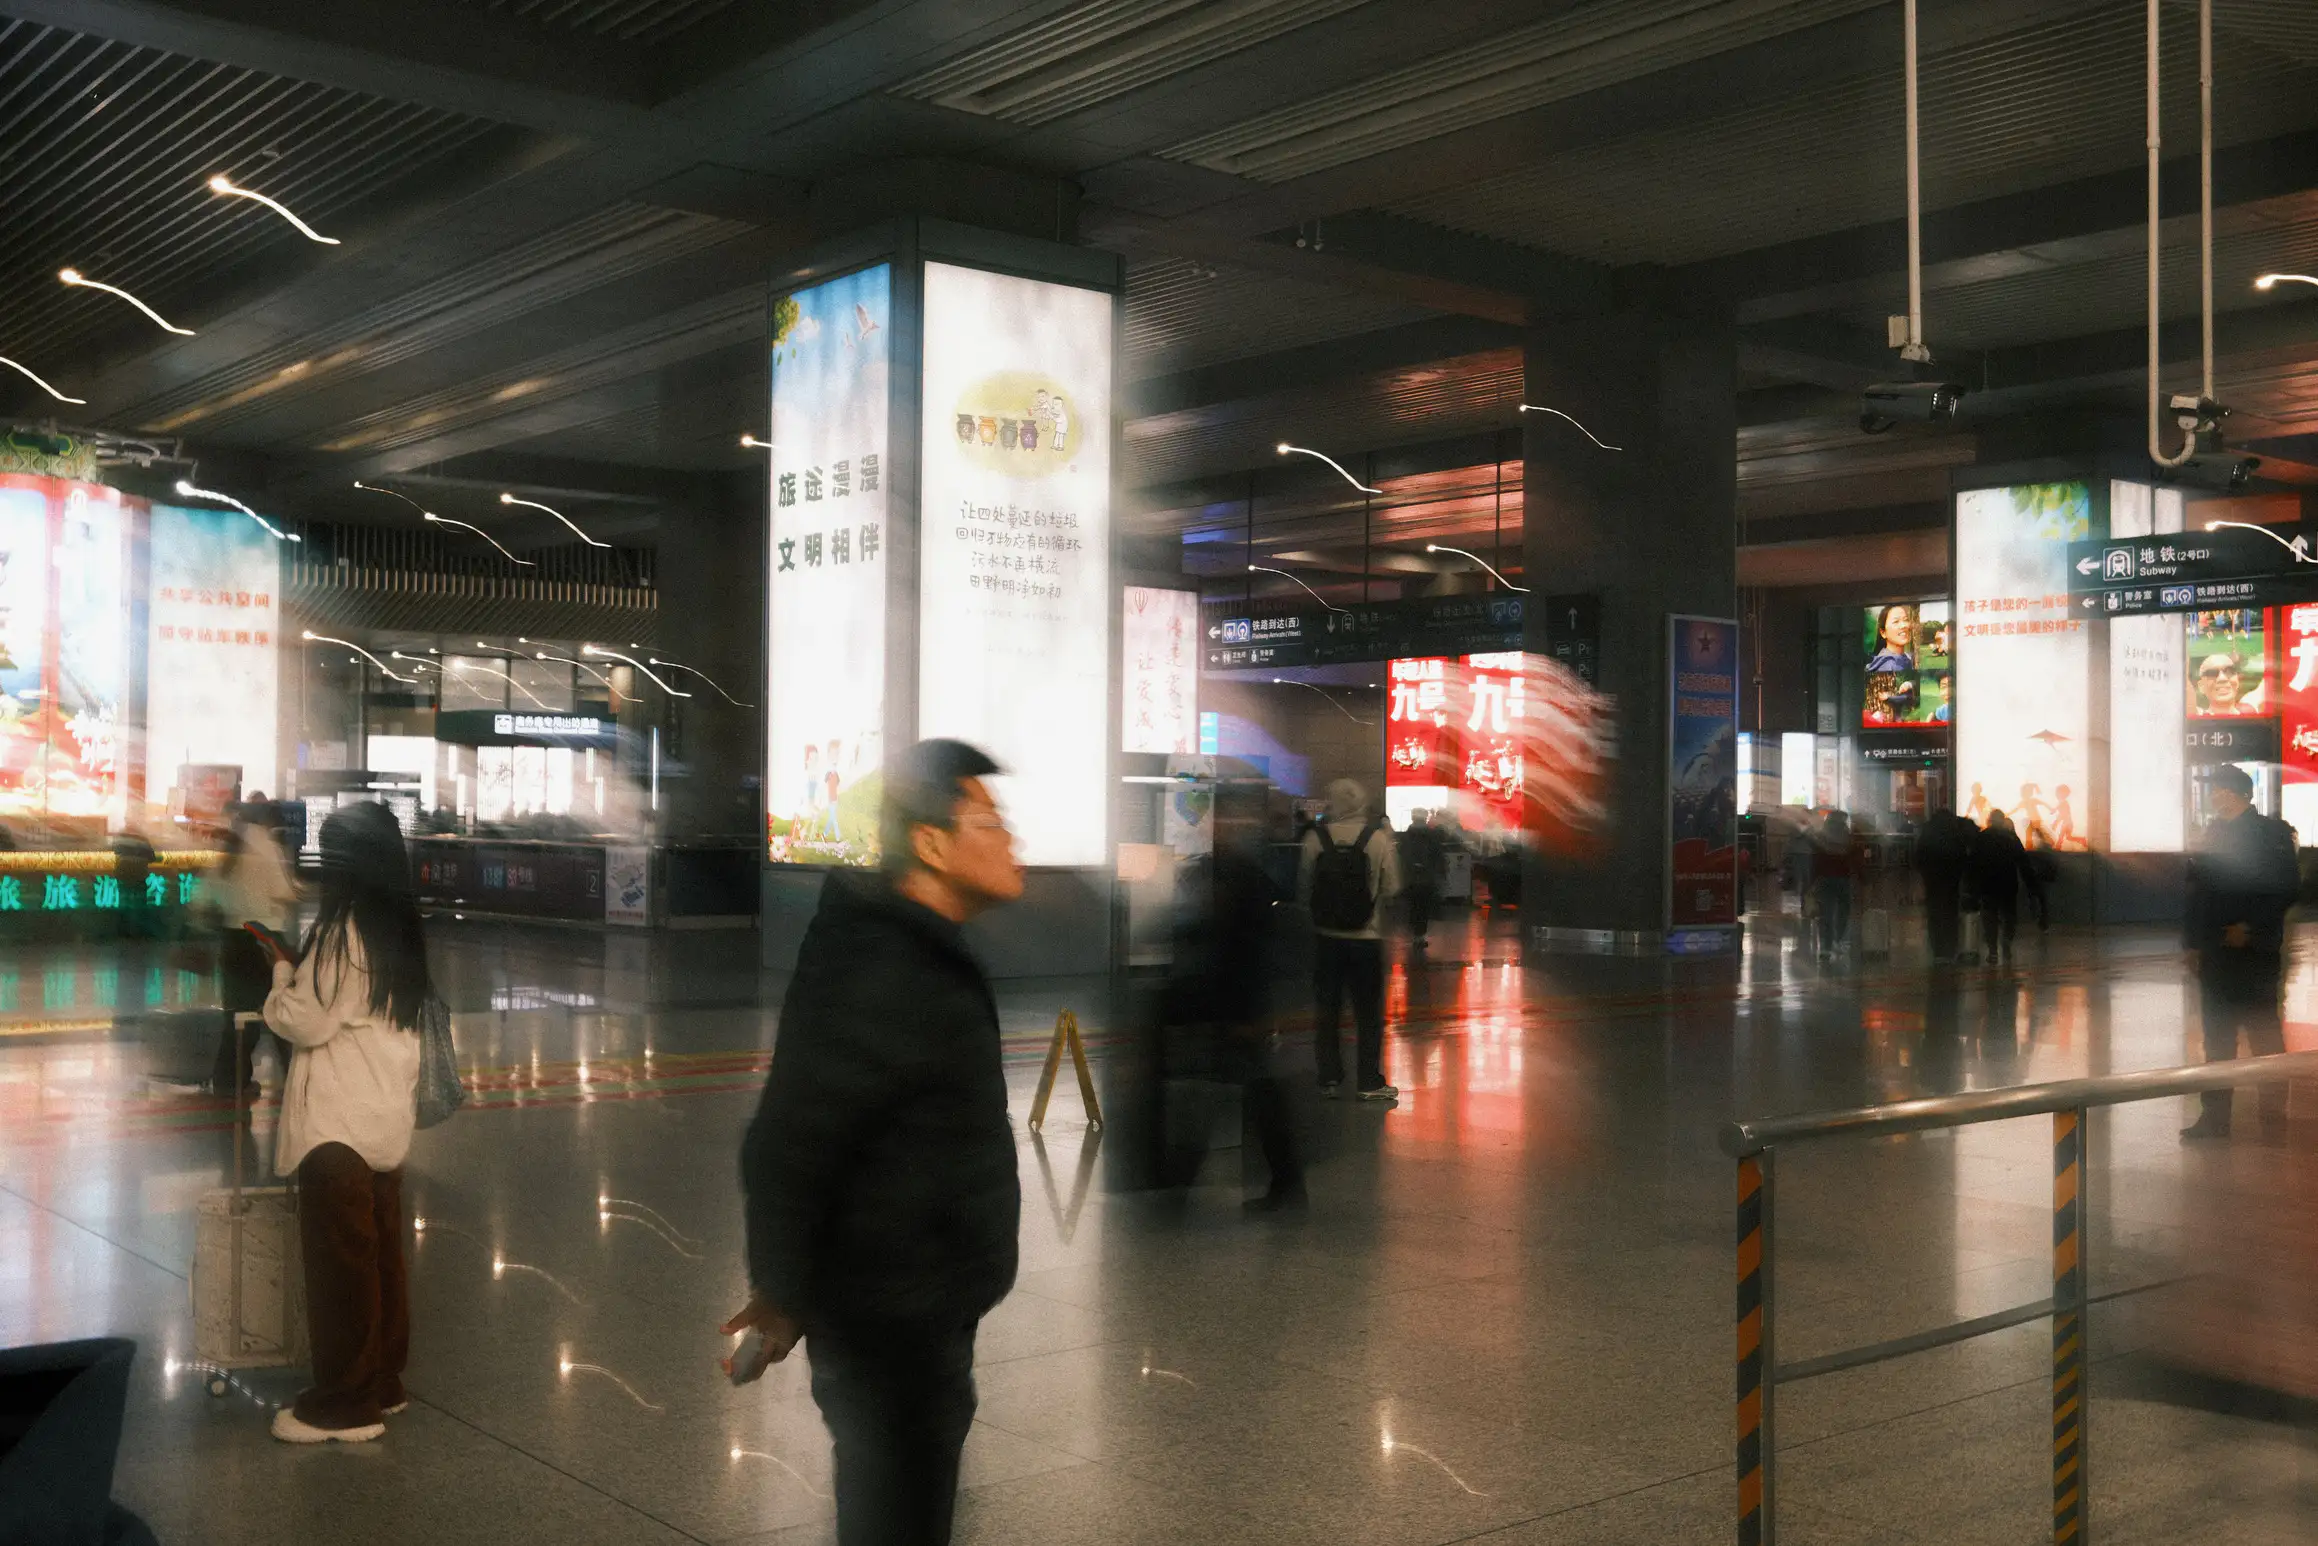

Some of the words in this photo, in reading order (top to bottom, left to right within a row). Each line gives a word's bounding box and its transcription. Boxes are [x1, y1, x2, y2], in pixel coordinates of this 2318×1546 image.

[777, 453, 881, 508] 旅途漫漫
[960, 500, 1080, 529] 让四处蔓延的垃圾
[777, 522, 880, 573] 文明相伴
[956, 526, 1083, 552] 回归万物应有的循环
[971, 550, 1061, 575] 污水不再横流
[2139, 545, 2211, 564] 地铁(2号口)
[2139, 565, 2178, 577] Subway
[970, 574, 1062, 600] 田野明净如初
[2124, 590, 2153, 602] 警务室
[2196, 583, 2255, 597] 铁路到达(西)
[1252, 617, 1300, 631] 铁路到达(西)
[1391, 682, 1448, 722] 九号
